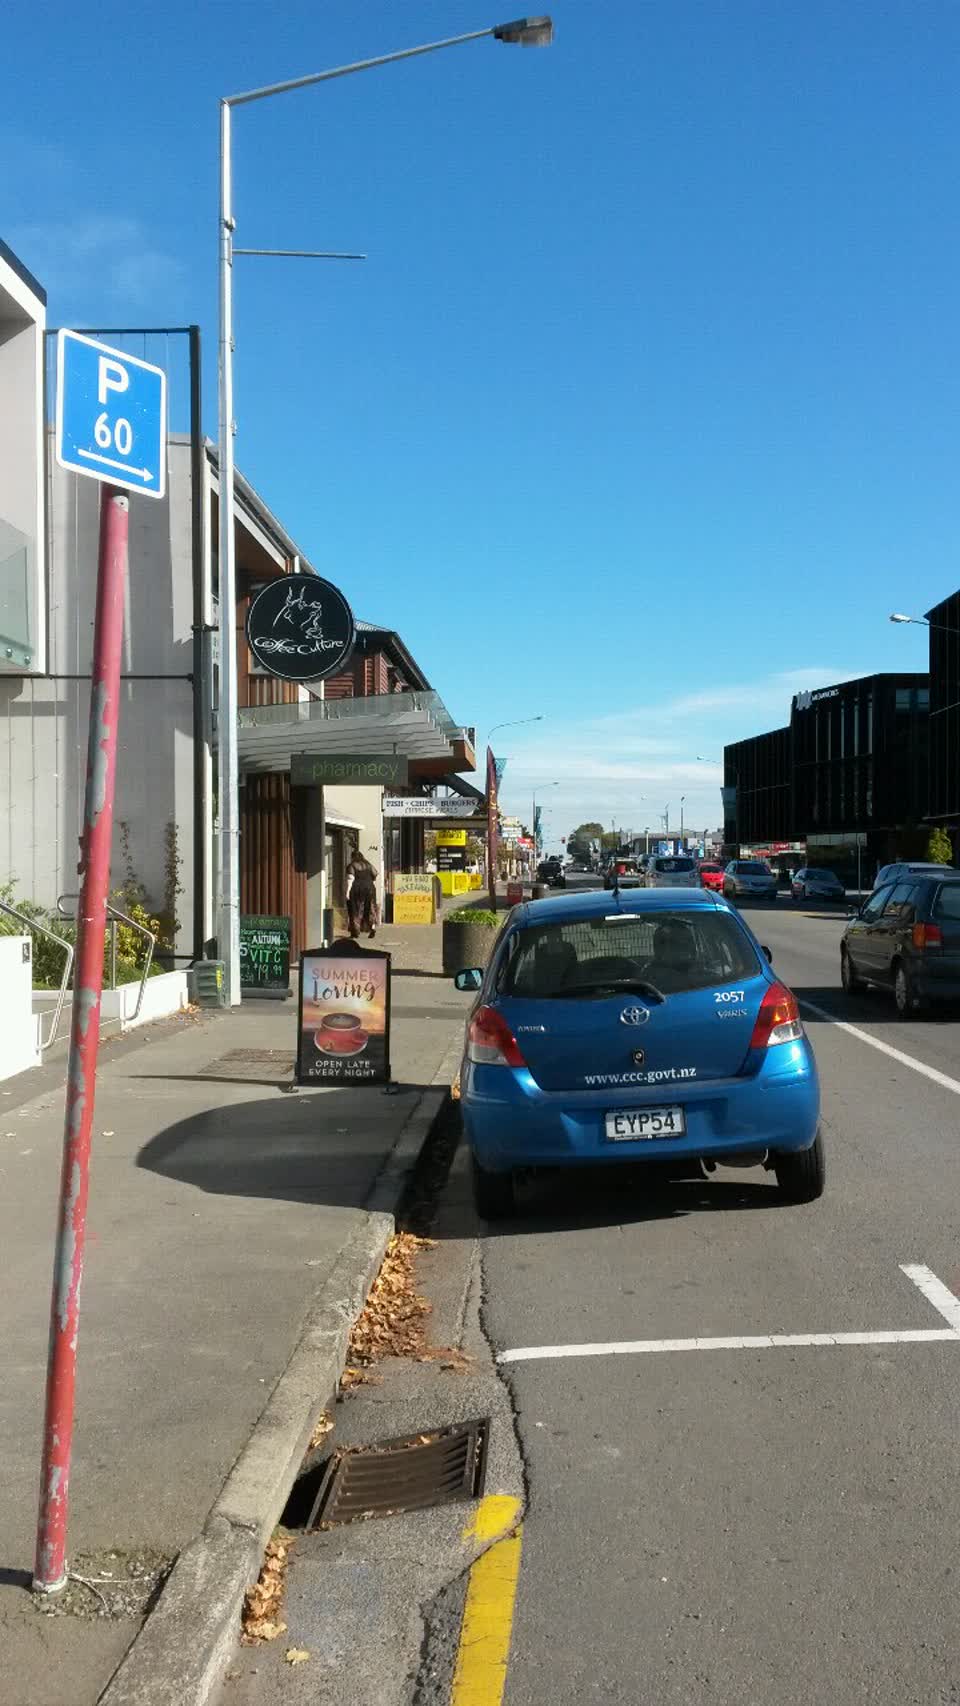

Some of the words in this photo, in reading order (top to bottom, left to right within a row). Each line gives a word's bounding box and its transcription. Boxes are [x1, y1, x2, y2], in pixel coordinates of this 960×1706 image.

[98, 355, 129, 404] P
[94, 411, 133, 456] 60
[254, 636, 297, 654] Coffee
[297, 639, 344, 655] Culture
[312, 759, 399, 784] pharmacy
[440, 799, 476, 807] BURGERS
[250, 949, 273, 963] VIT
[311, 968, 379, 982] SUMMER
[312, 979, 380, 1002] Loving
[713, 991, 745, 1004] 2057
[308, 1068, 341, 1077] EVERY
[344, 1068, 376, 1077] NIGHT
[315, 1060, 343, 1069] OPEN
[347, 1060, 371, 1069] LATE
[584, 1065, 697, 1086] www.ccc.govt.nz
[614, 1111, 676, 1134] EYP54
